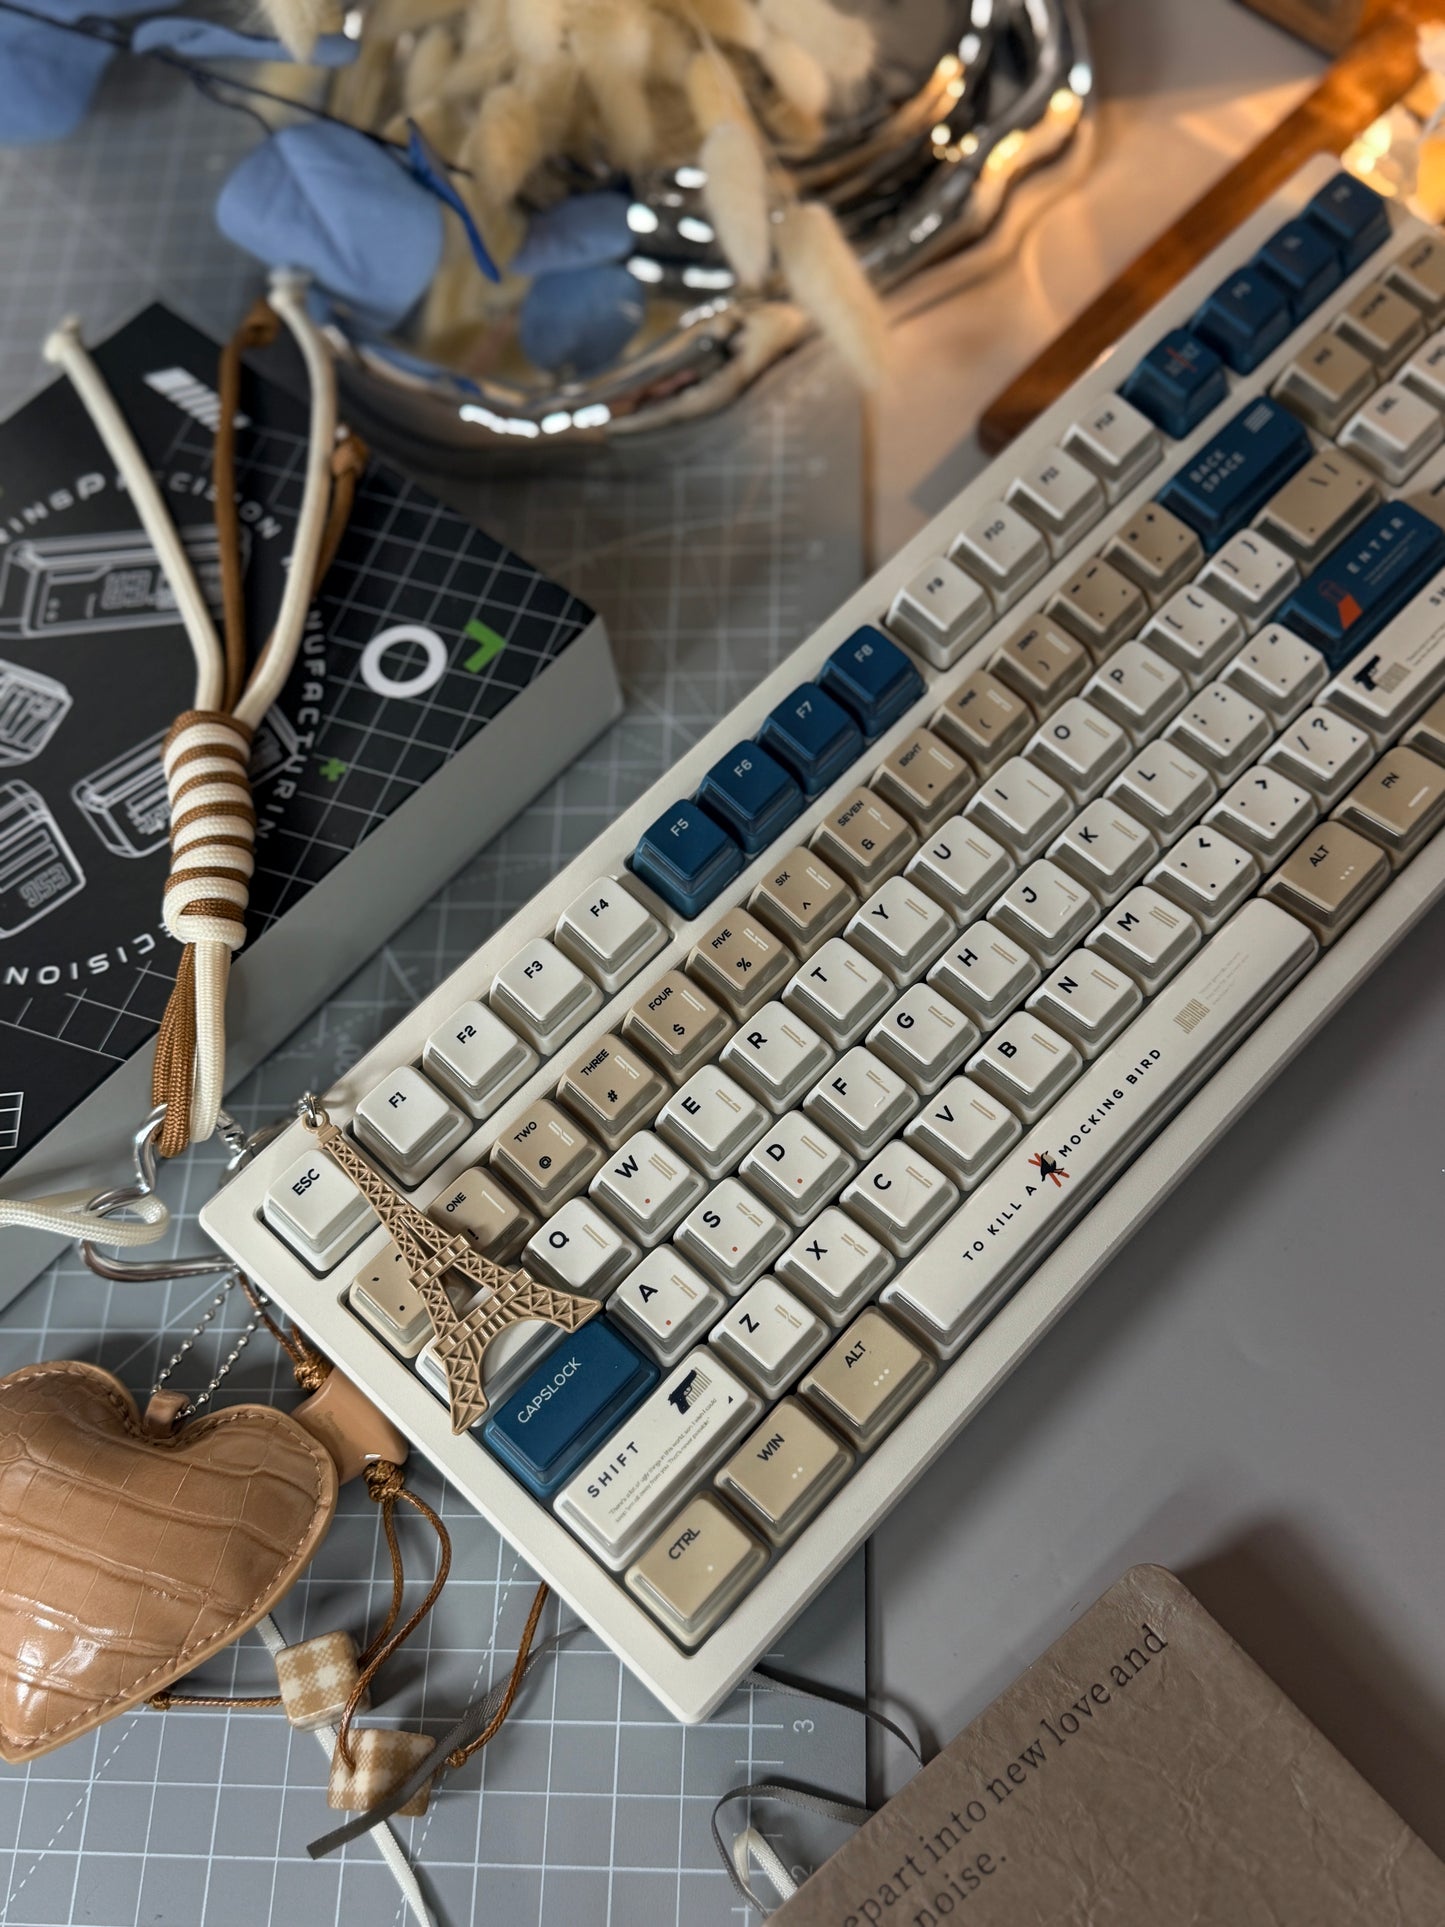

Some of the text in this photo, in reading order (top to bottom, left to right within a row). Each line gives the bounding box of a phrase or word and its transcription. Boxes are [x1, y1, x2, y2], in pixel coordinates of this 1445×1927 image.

[1189, 449, 1227, 483] BACK
[1200, 451, 1244, 491] SPACE
[1346, 516, 1405, 575] ENTER
[1110, 669, 1123, 683] P
[796, 701, 811, 718] F7
[1054, 725, 1070, 739] O
[734, 760, 752, 776] F6
[1138, 771, 1156, 781] L
[1382, 773, 1399, 788] FN
[995, 789, 1008, 800] I
[838, 801, 864, 826] SEVEN
[671, 819, 688, 836] F5
[1079, 827, 1098, 843] K
[933, 844, 951, 859] U
[1310, 845, 1328, 867] ALT
[775, 872, 790, 886] SIX
[1022, 887, 1037, 903] J
[590, 899, 608, 917] F4
[872, 904, 888, 919] Y
[1117, 912, 1139, 931] M
[712, 929, 731, 948] FIVE
[737, 958, 751, 971] %
[958, 948, 978, 967] H
[524, 961, 542, 978] F3
[811, 967, 827, 982] T
[1058, 976, 1078, 993] N
[649, 988, 673, 1010] FOUR
[897, 1013, 914, 1028] G
[457, 1026, 476, 1043] F2
[673, 1024, 685, 1035] $
[747, 1032, 767, 1049] R
[998, 1042, 1017, 1058] B
[581, 1049, 609, 1075] THREE
[832, 1078, 847, 1095] F
[389, 1092, 406, 1108] F1
[681, 1097, 701, 1114] E
[936, 1105, 954, 1122] V
[514, 1122, 536, 1142] TWO
[766, 1144, 785, 1161] D
[963, 1050, 1160, 1260] TO KILL A MOCKING BIRD
[539, 1156, 551, 1169] @
[615, 1155, 638, 1178] W
[292, 1169, 319, 1195] ESC
[874, 1174, 891, 1190] C
[446, 1193, 466, 1212] ONE
[703, 1211, 720, 1228] S
[549, 1231, 569, 1248] Q
[806, 1240, 827, 1260] X
[639, 1285, 658, 1303] A
[739, 1314, 759, 1333] Z
[845, 1341, 865, 1368] ALT
[517, 1357, 583, 1424] CAPSLOCK
[757, 1434, 784, 1460] WIN
[587, 1441, 640, 1499] SHIFT
[669, 1529, 700, 1559] CTRL
[793, 1720, 814, 1732] 3
[919, 1800, 987, 1863] into
[986, 1739, 1046, 1803] new
[1040, 1684, 1110, 1746] love
[1110, 1623, 1168, 1687] and
[912, 1852, 1006, 1927] noise.
